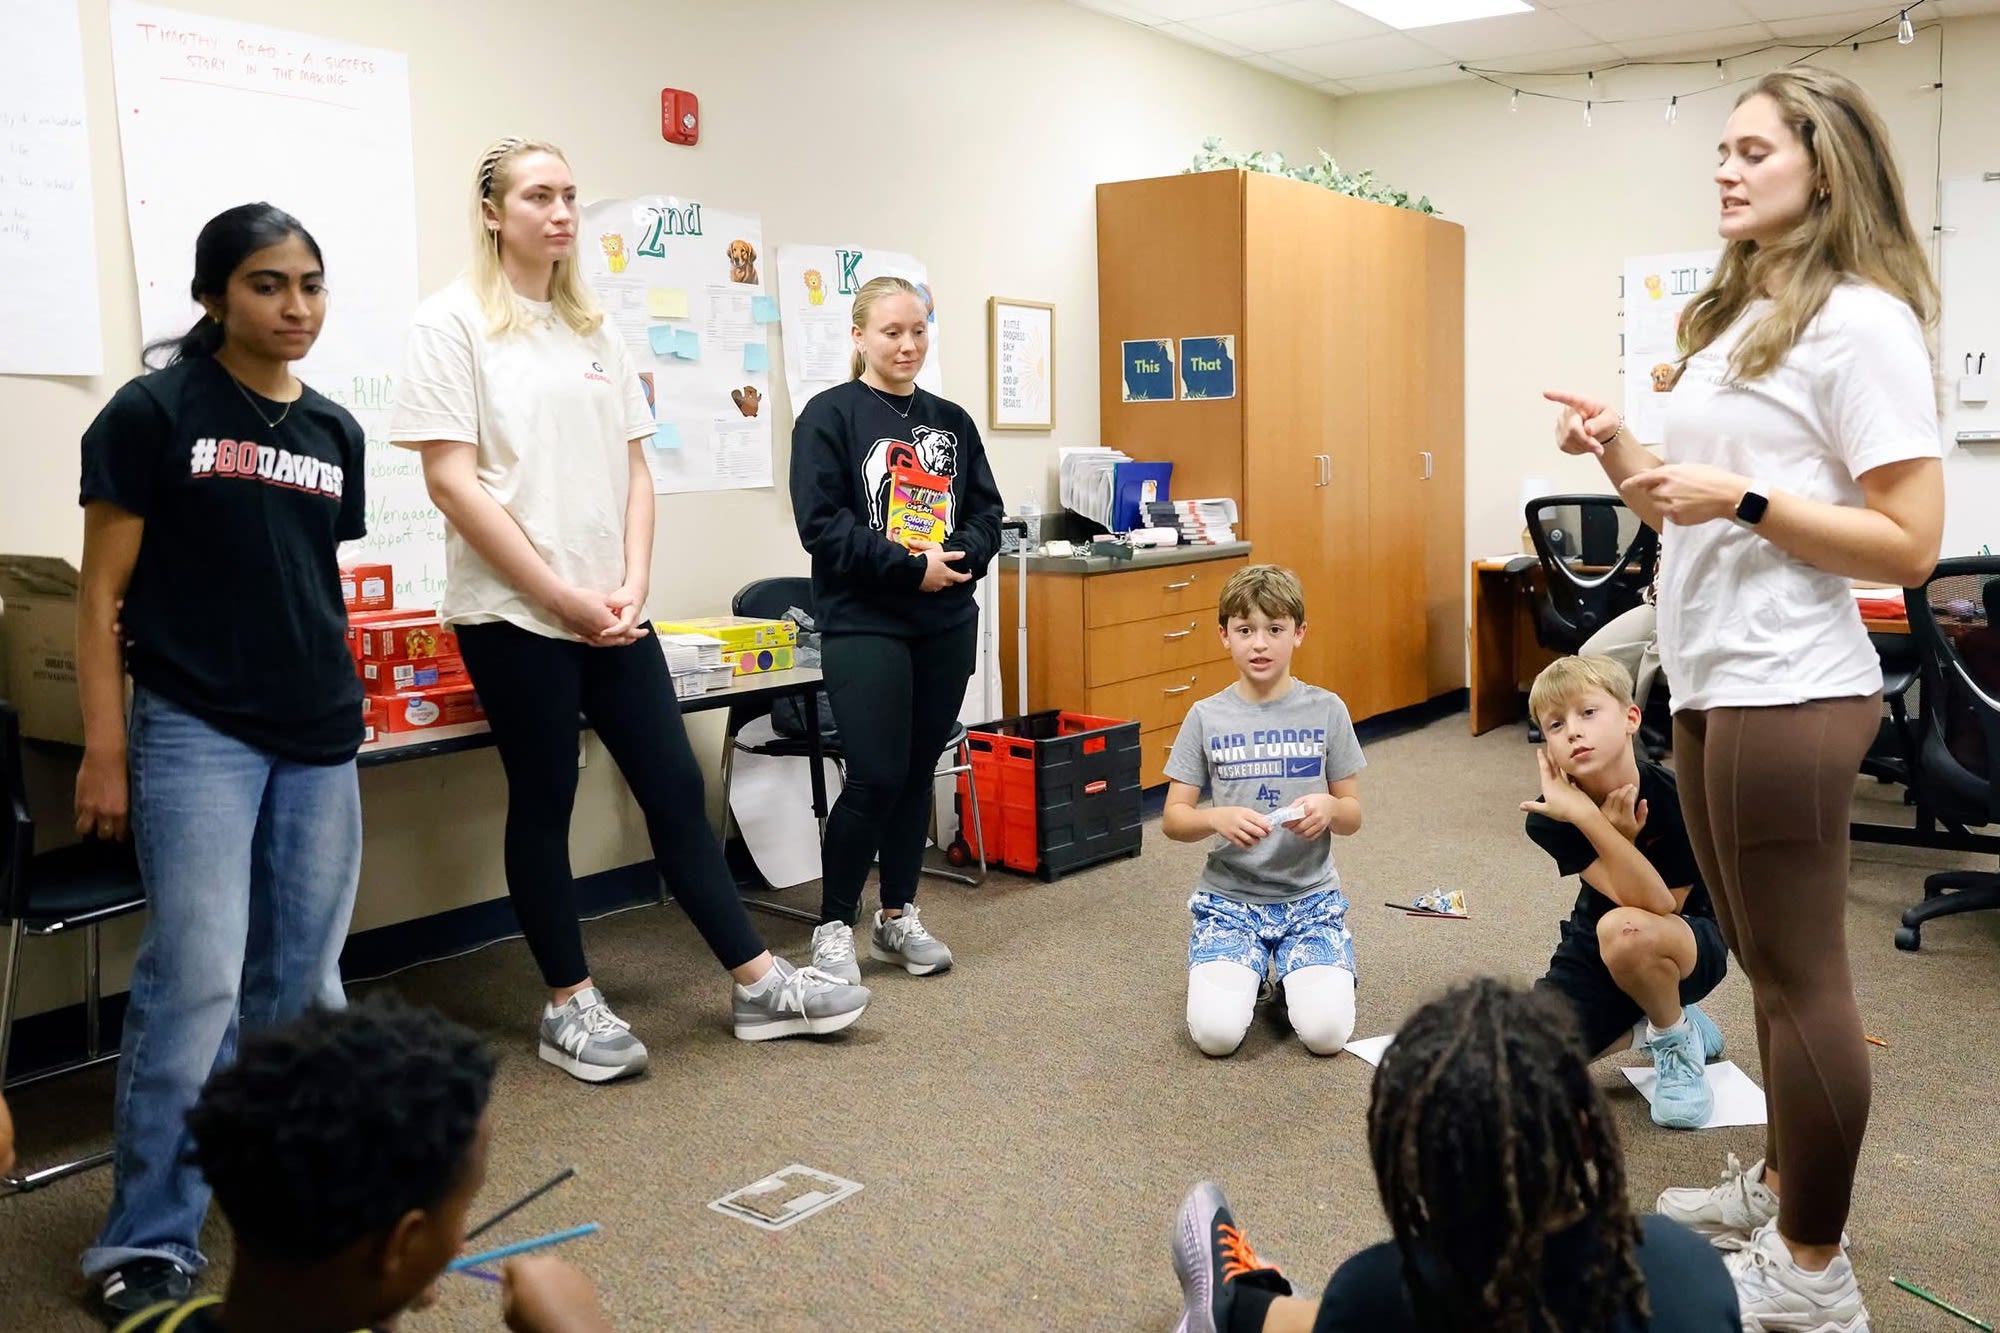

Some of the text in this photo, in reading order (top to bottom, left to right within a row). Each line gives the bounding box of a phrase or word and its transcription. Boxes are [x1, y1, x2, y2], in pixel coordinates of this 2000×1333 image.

[136, 23, 217, 49] TIMOTHY
[303, 52, 312, 65] A
[325, 56, 375, 75] SUCCESS
[186, 54, 349, 87] STORY IN THE MAKING
[637, 203, 703, 258] 2nd
[836, 250, 862, 294] K
[1134, 358, 1160, 374] This
[1190, 356, 1222, 372] That
[189, 437, 344, 499] #GODAWGS
[902, 513, 936, 527] Colored
[904, 521, 931, 534] Pencils
[420, 564, 448, 593] tim
[1211, 729, 1325, 762] AIR FORCE
[1218, 761, 1283, 778] BASKETBALL
